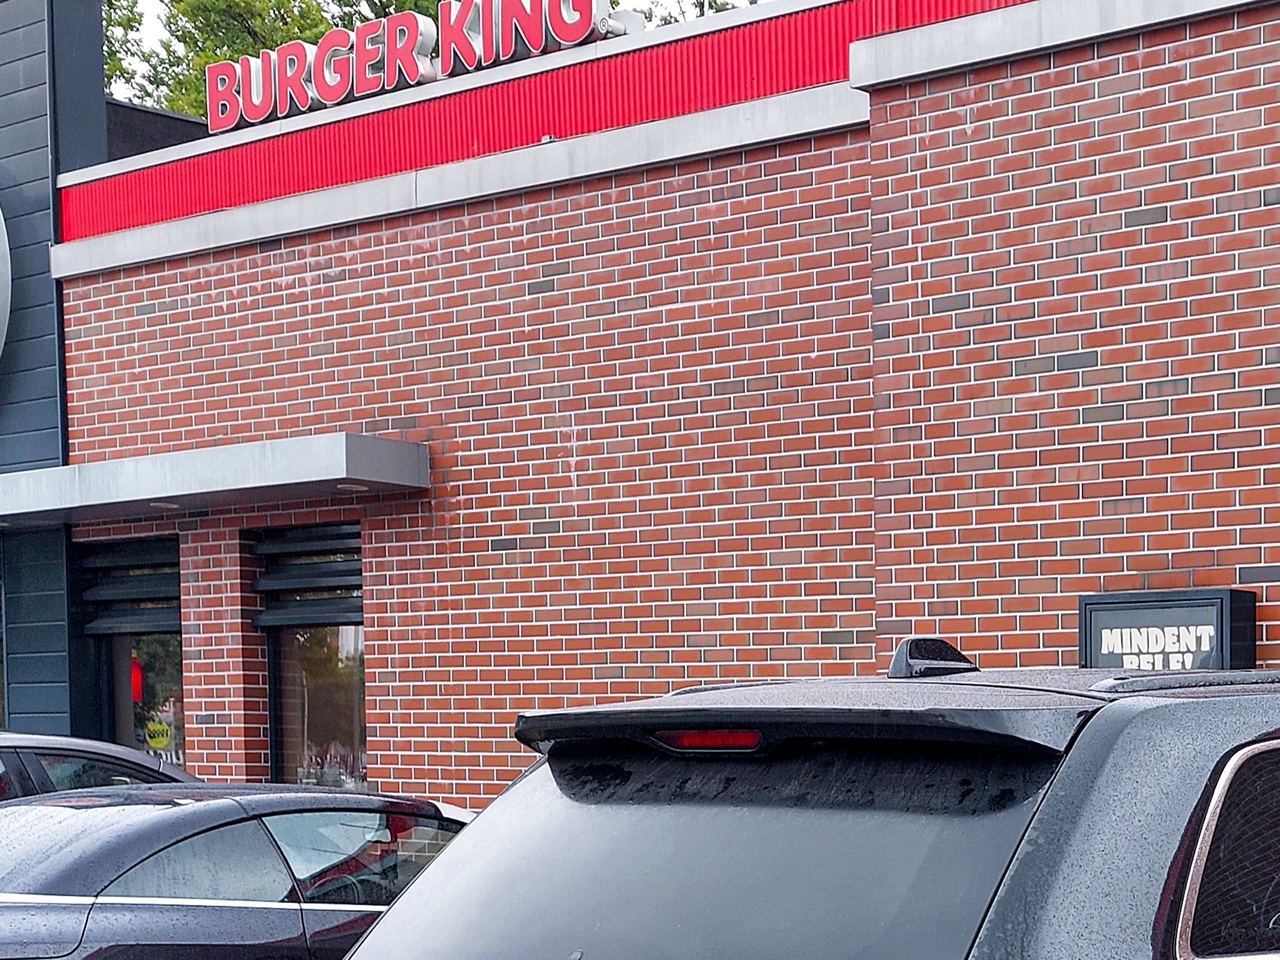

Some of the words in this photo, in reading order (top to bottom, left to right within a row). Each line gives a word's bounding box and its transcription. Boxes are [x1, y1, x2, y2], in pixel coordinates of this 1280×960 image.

[206, 10, 424, 133] BURGER
[439, 0, 596, 76] KING
[1101, 625, 1215, 654] MINDENT
